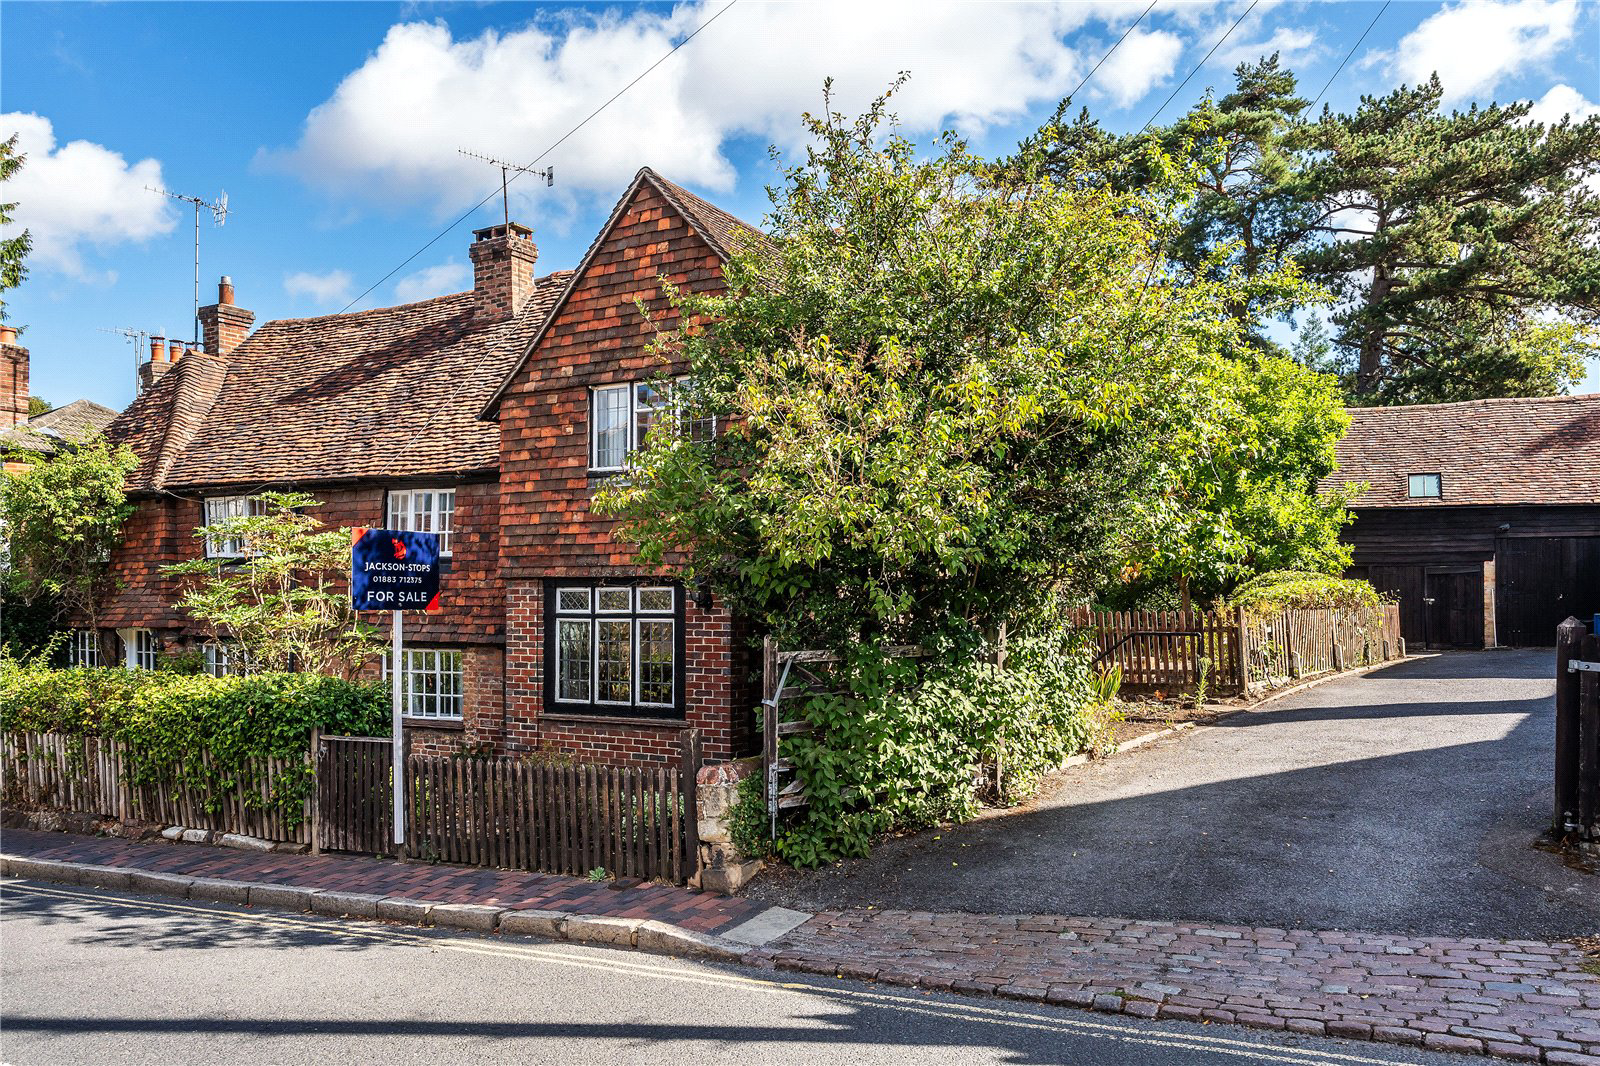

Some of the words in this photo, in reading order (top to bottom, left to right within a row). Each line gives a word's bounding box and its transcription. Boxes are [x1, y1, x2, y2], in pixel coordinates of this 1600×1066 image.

[364, 562, 431, 572] JACKSON-STOPS
[399, 576, 422, 584] 712375
[367, 591, 394, 602] FOR
[398, 591, 427, 602] SALE
